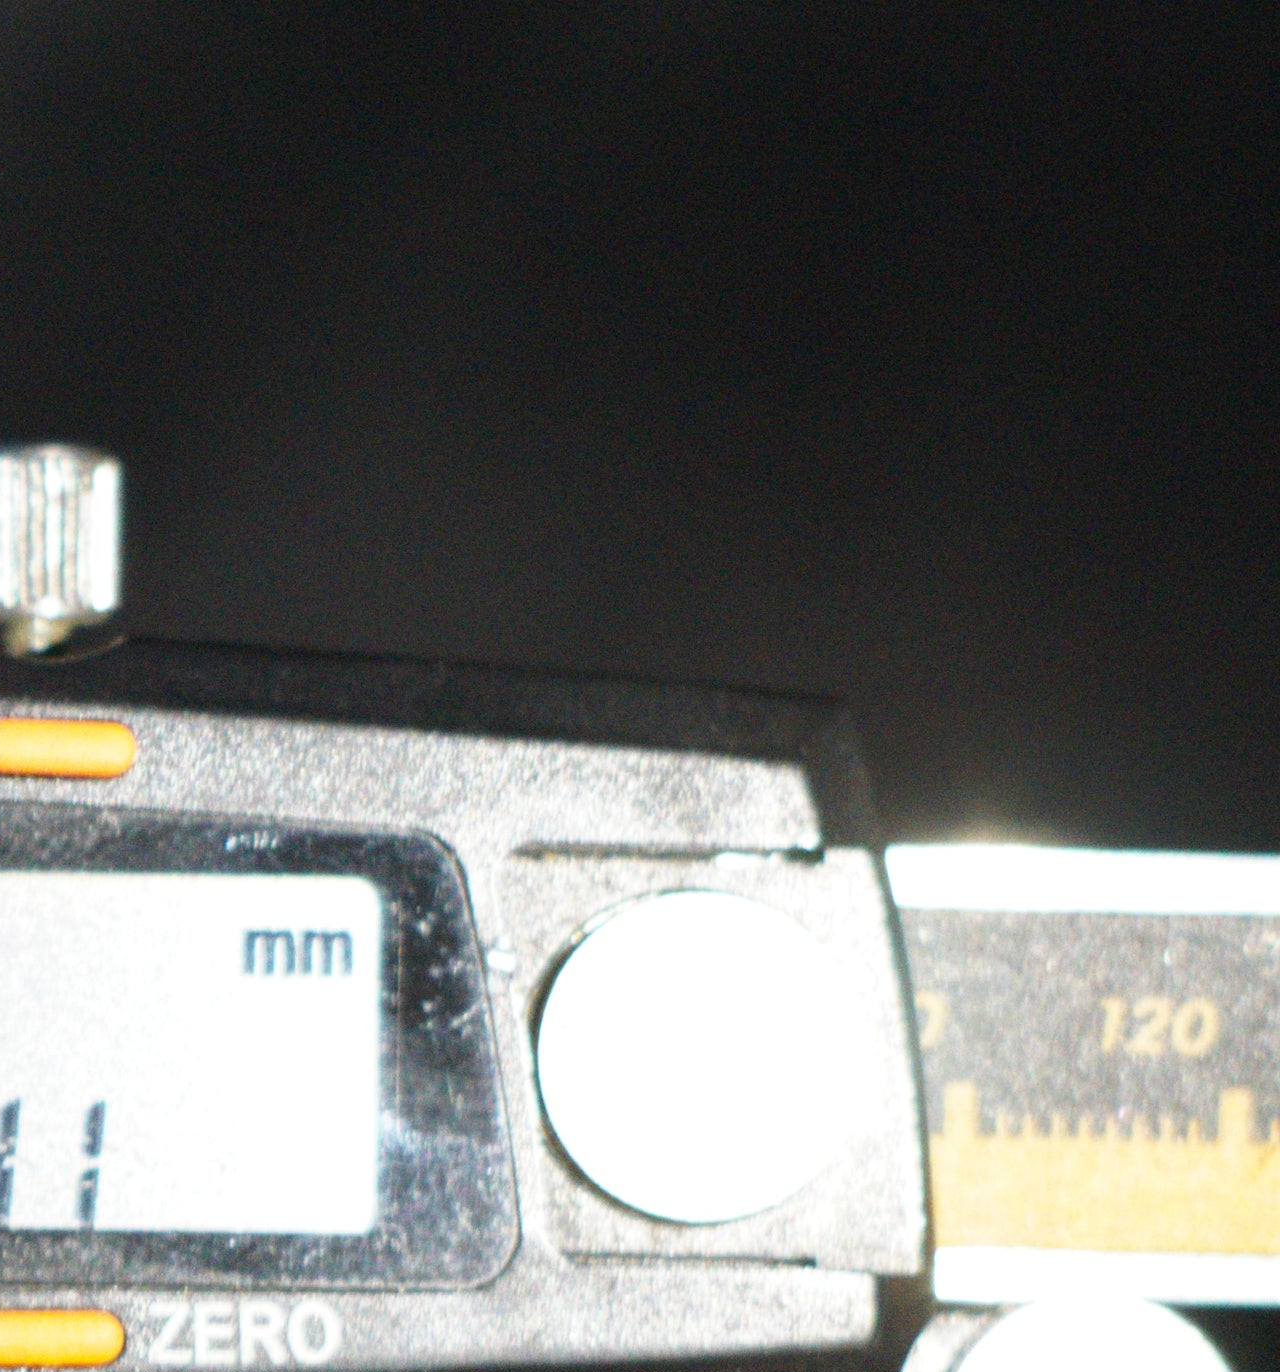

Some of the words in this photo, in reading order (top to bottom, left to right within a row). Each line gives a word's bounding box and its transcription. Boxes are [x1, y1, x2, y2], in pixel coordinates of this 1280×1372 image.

[243, 928, 354, 976] mm
[1100, 995, 1218, 1058] 120
[146, 1302, 342, 1367] ZERO
